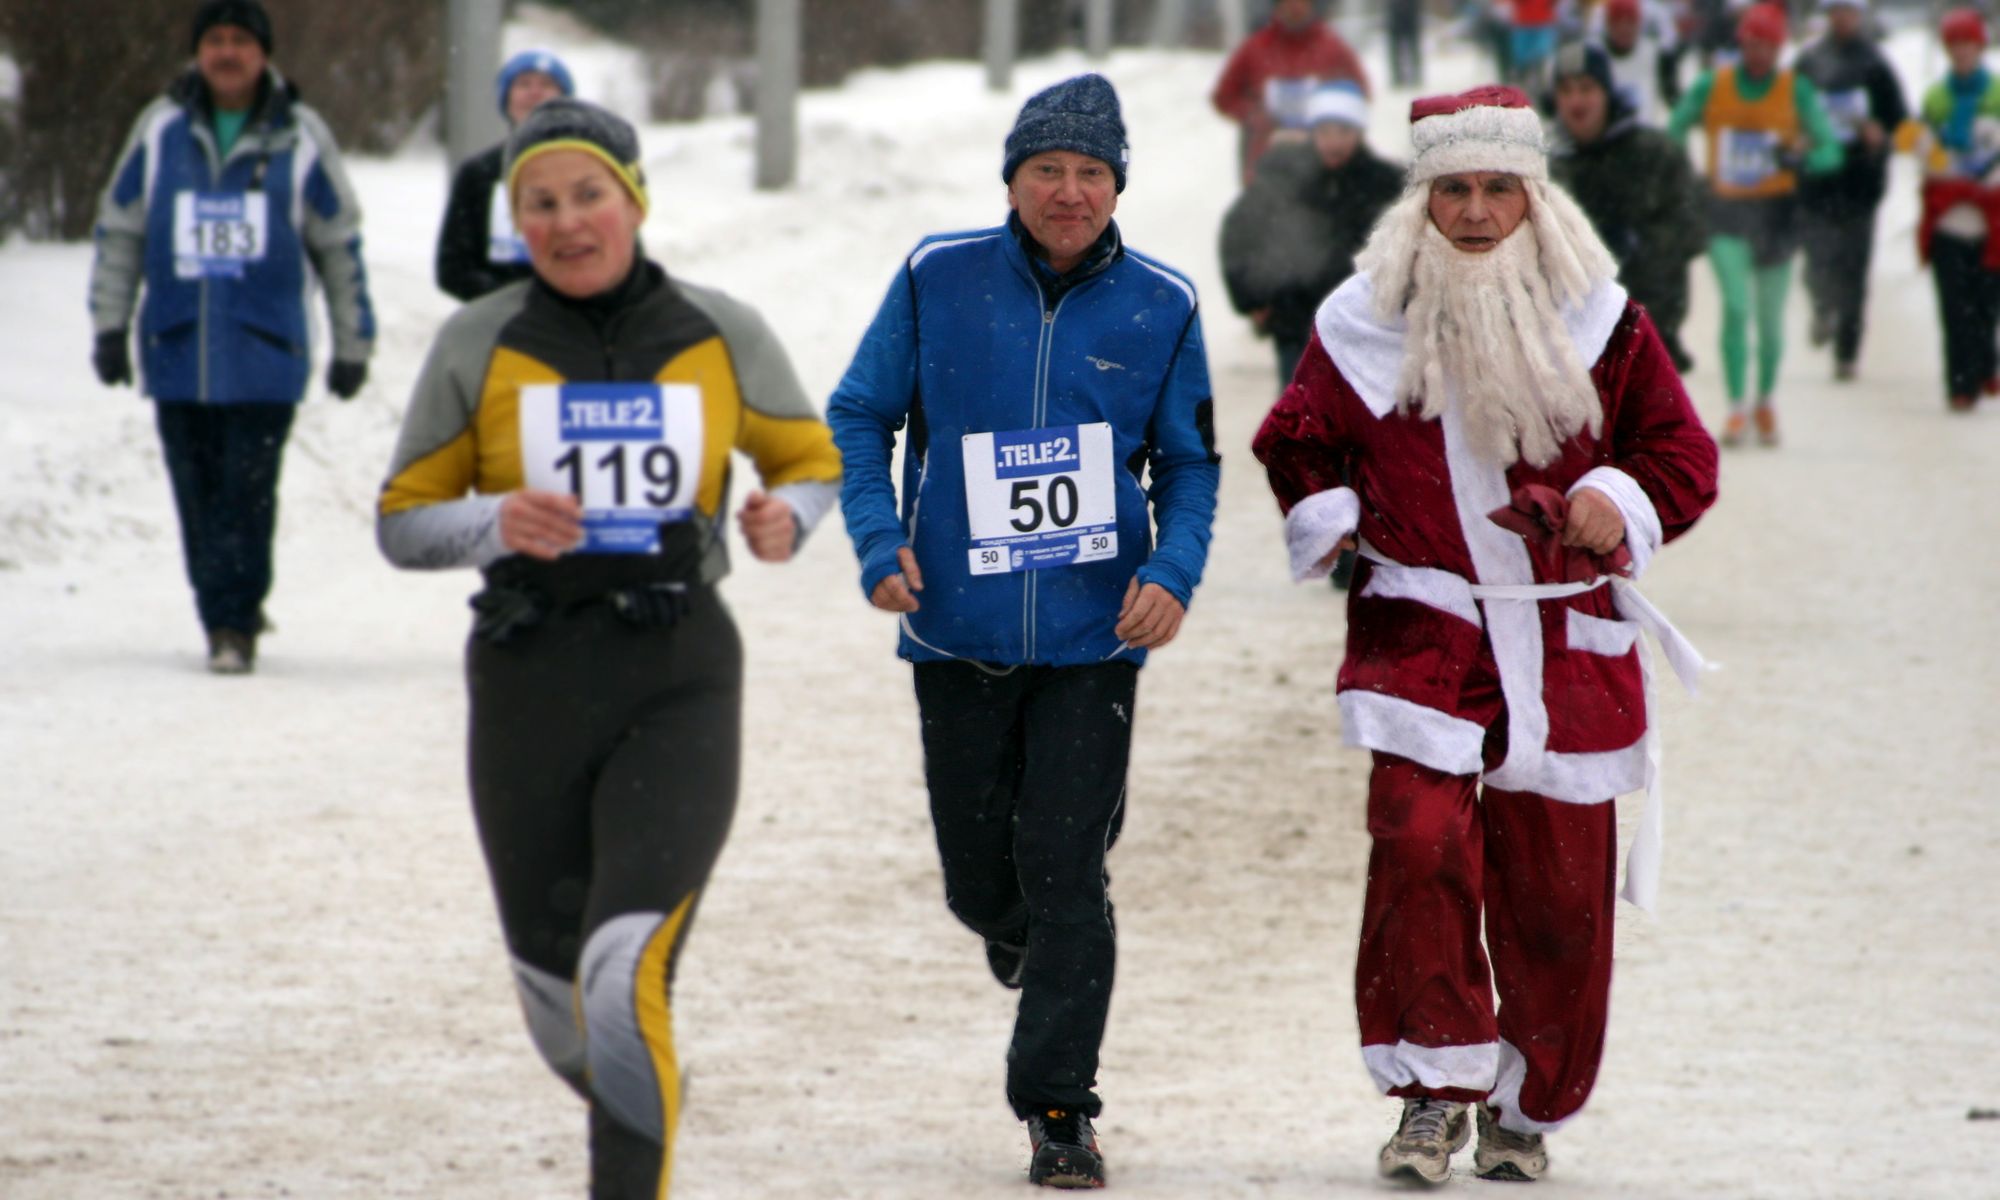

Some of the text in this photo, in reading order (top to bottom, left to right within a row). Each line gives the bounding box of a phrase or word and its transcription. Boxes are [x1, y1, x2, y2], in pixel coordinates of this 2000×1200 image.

[191, 222, 256, 255] 183
[553, 444, 681, 508] 119
[1009, 475, 1079, 533] 50
[981, 551, 999, 564] 50
[1091, 537, 1108, 550] 50
